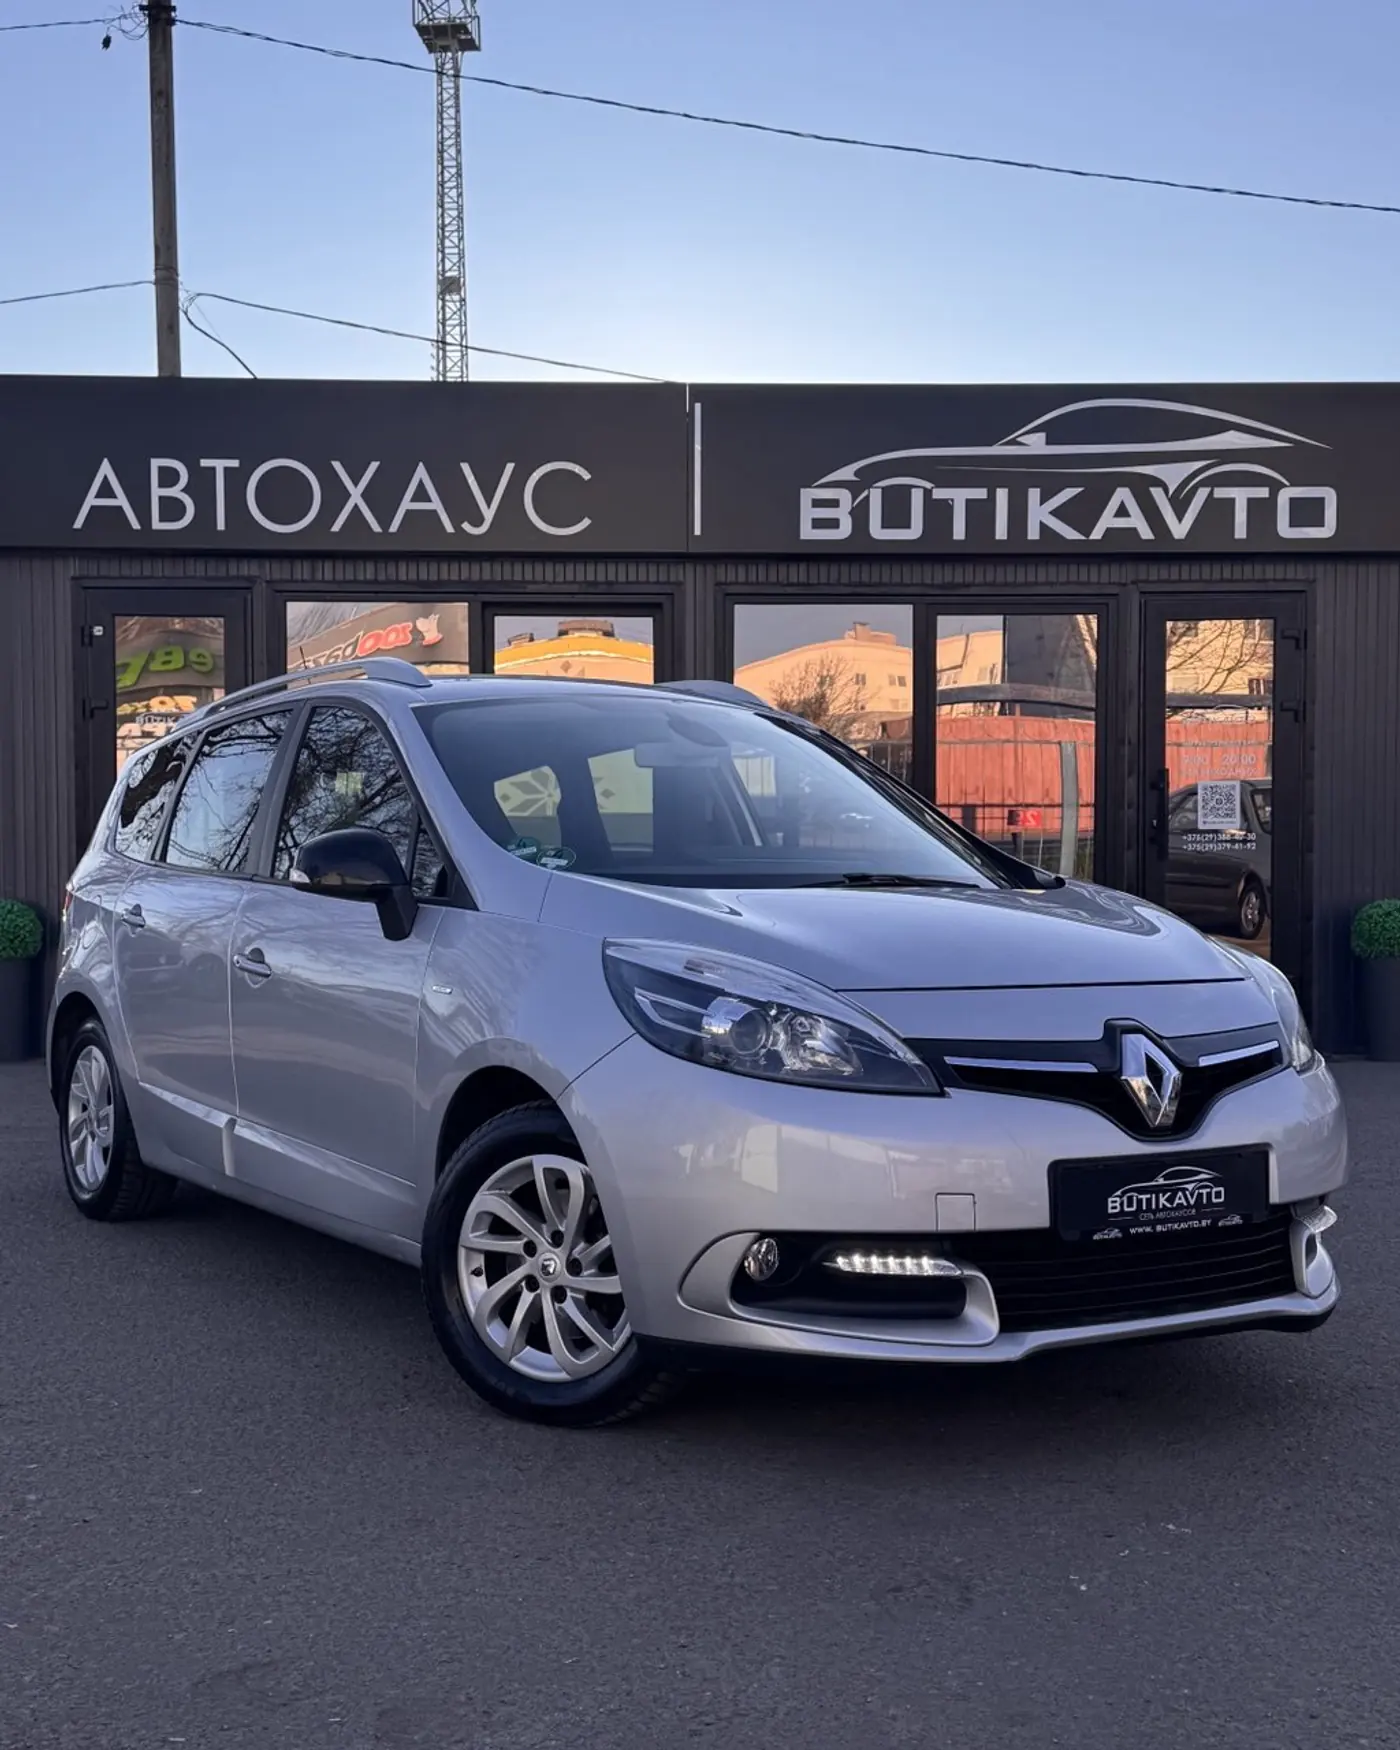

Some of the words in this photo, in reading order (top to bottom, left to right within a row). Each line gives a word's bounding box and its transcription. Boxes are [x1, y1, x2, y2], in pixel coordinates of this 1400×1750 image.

[73, 457, 592, 536] АВТОХАУС
[799, 485, 1338, 541] BUTIKAVTO
[1107, 1187, 1225, 1213] BUTIKAVTO
